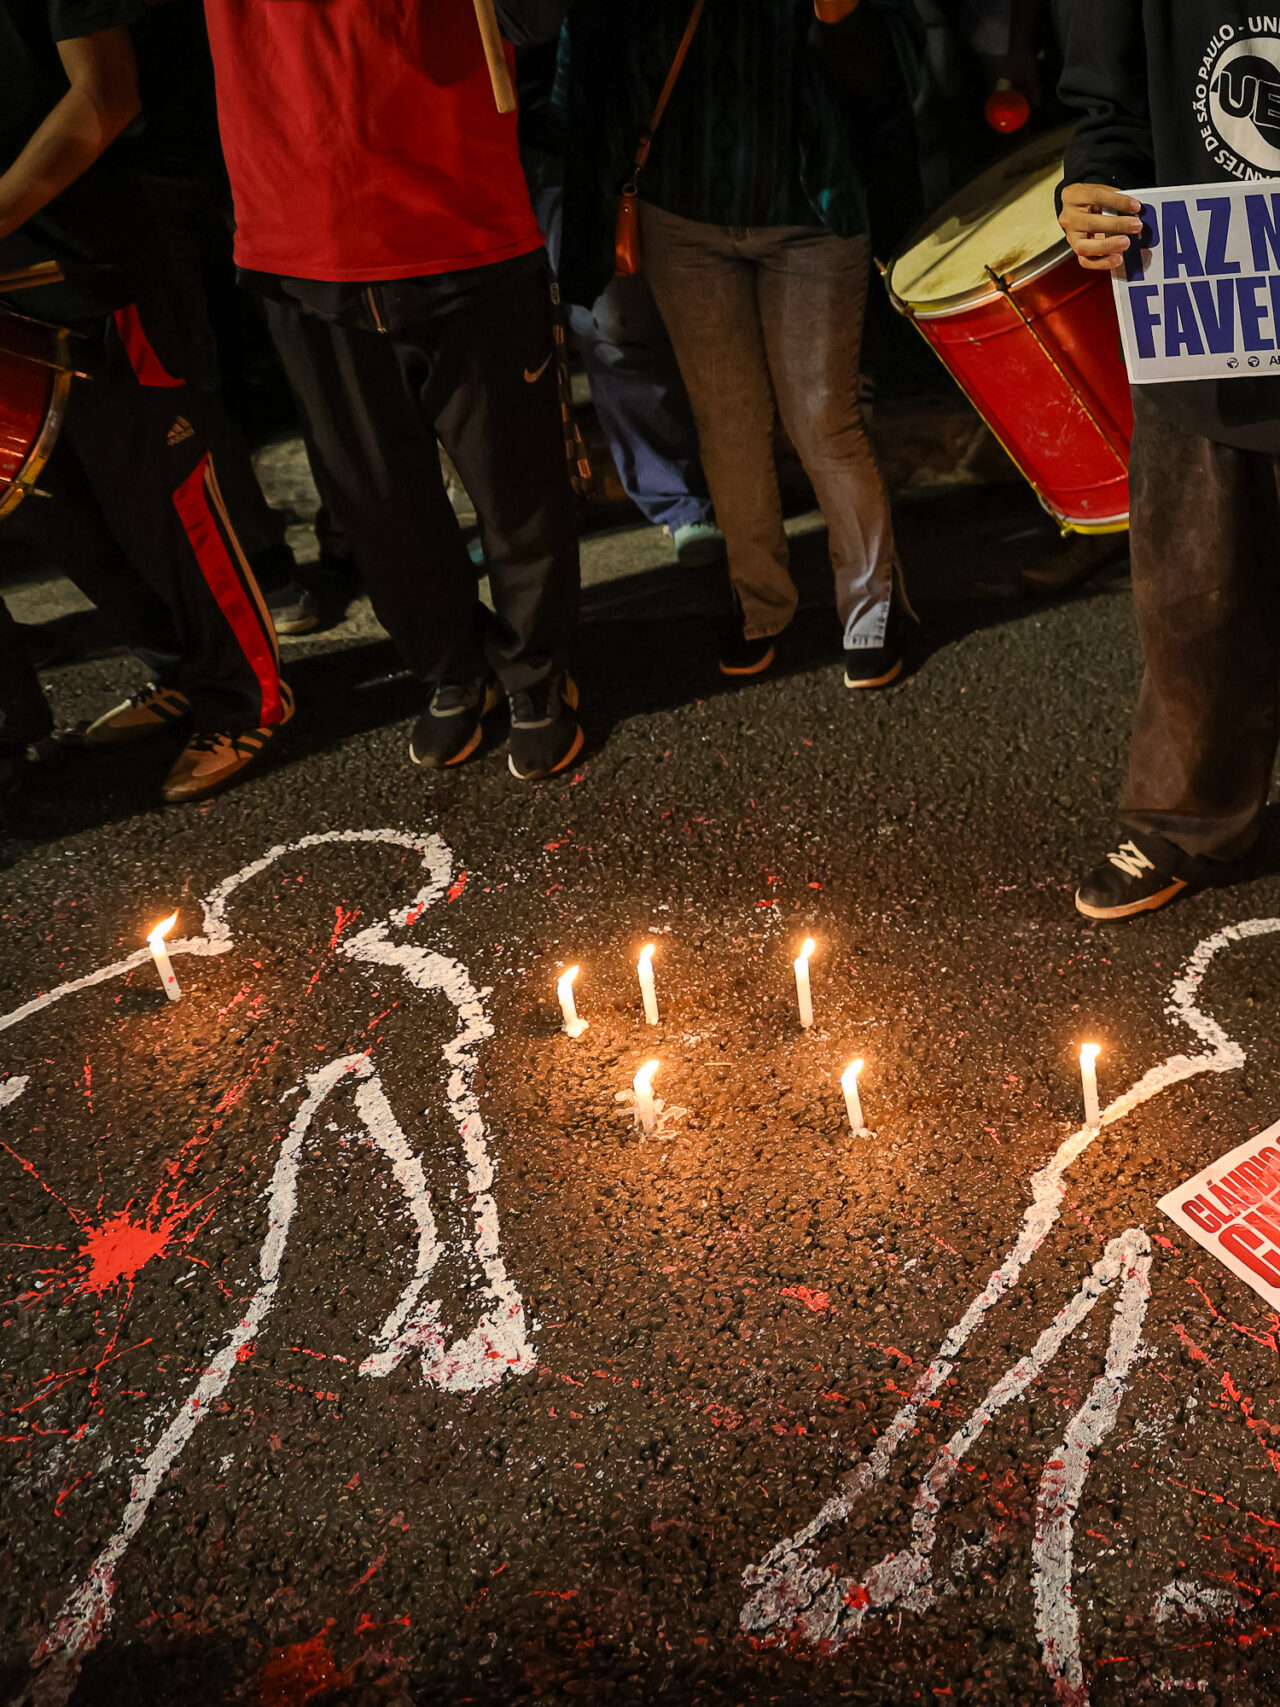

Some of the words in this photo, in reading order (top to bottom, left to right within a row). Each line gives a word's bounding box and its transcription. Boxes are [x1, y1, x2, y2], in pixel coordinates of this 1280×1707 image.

[1198, 24, 1235, 80] PAULO
[1193, 84, 1208, 122] SÃO
[1201, 125, 1219, 152] DE
[1122, 197, 1241, 282] PAZ
